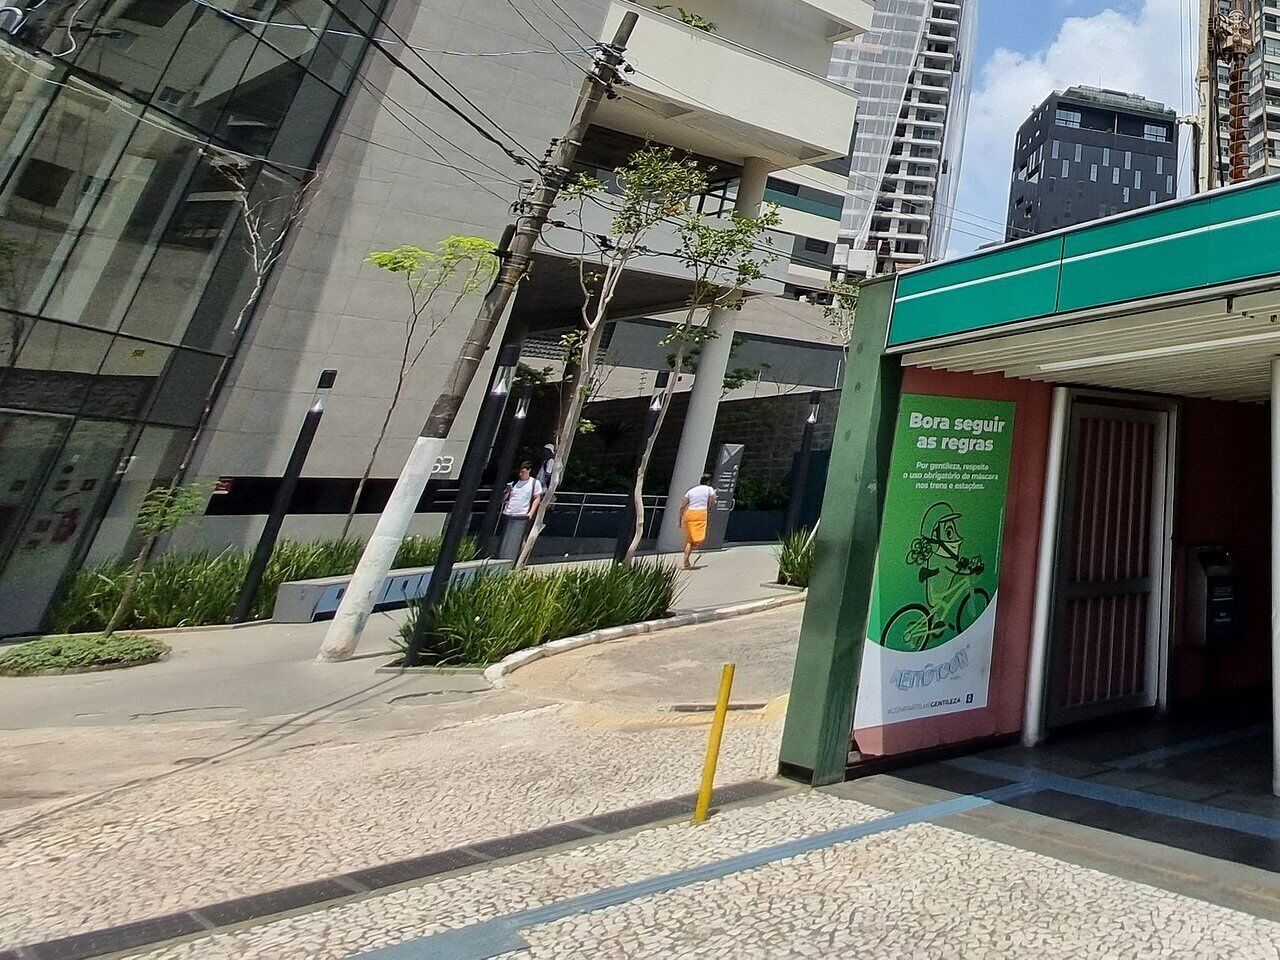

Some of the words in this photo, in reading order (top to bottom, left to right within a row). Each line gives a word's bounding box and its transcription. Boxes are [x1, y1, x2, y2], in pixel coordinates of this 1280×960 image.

[910, 412, 950, 429] Bora
[954, 416, 1005, 435] seguir
[916, 435, 937, 449] as
[941, 437, 994, 454] regras
[916, 461, 929, 469] Por
[930, 462, 962, 471] gentileza,
[923, 472, 961, 481] obrigatório
[929, 482, 948, 490] trens
